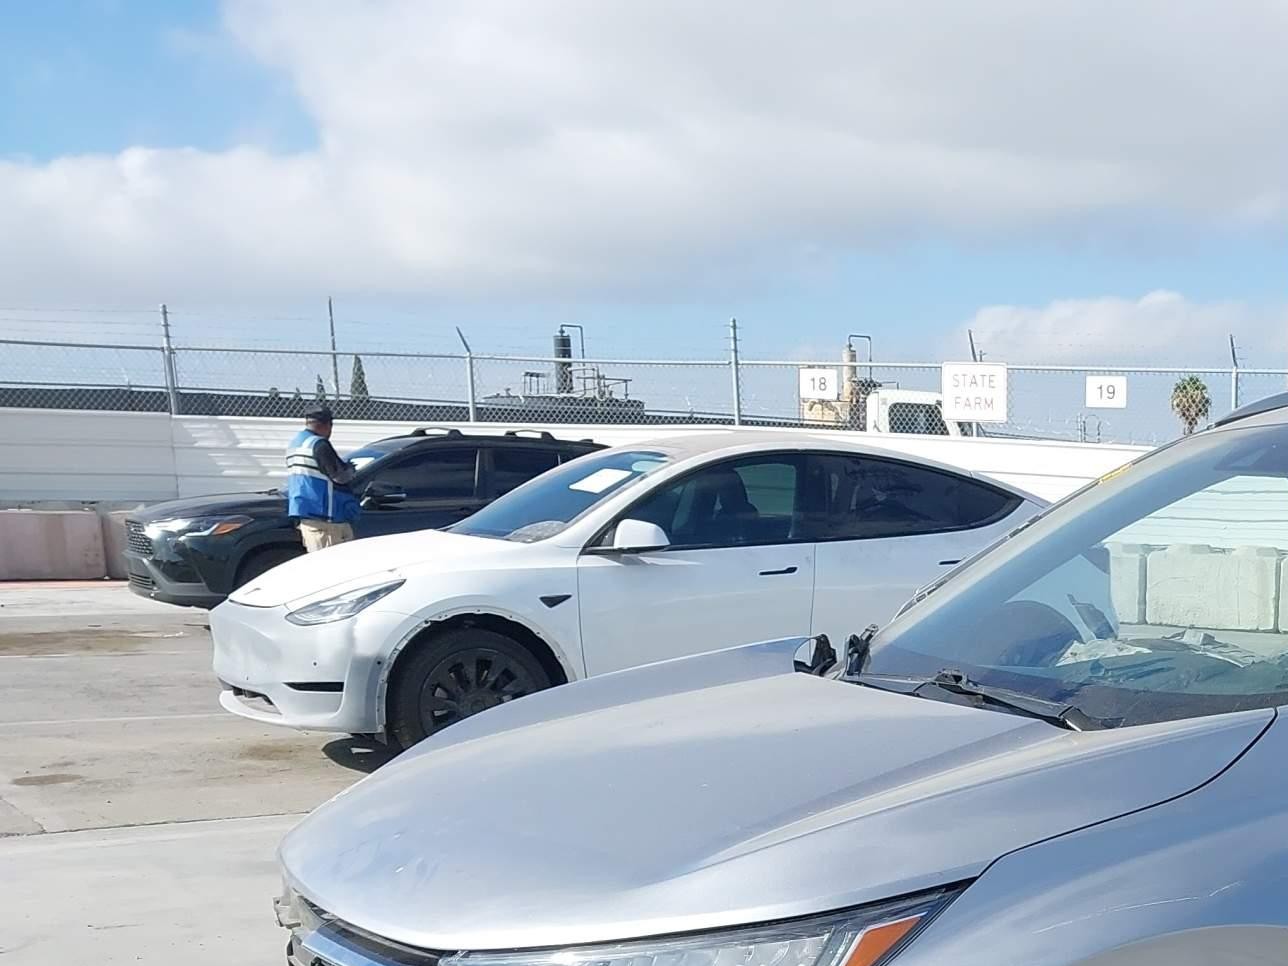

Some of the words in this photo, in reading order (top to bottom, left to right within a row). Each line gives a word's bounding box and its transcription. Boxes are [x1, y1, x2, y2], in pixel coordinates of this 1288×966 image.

[810, 376, 828, 392] 18
[952, 373, 996, 389] STATE
[1096, 384, 1116, 400] 19
[954, 396, 995, 411] FARM
